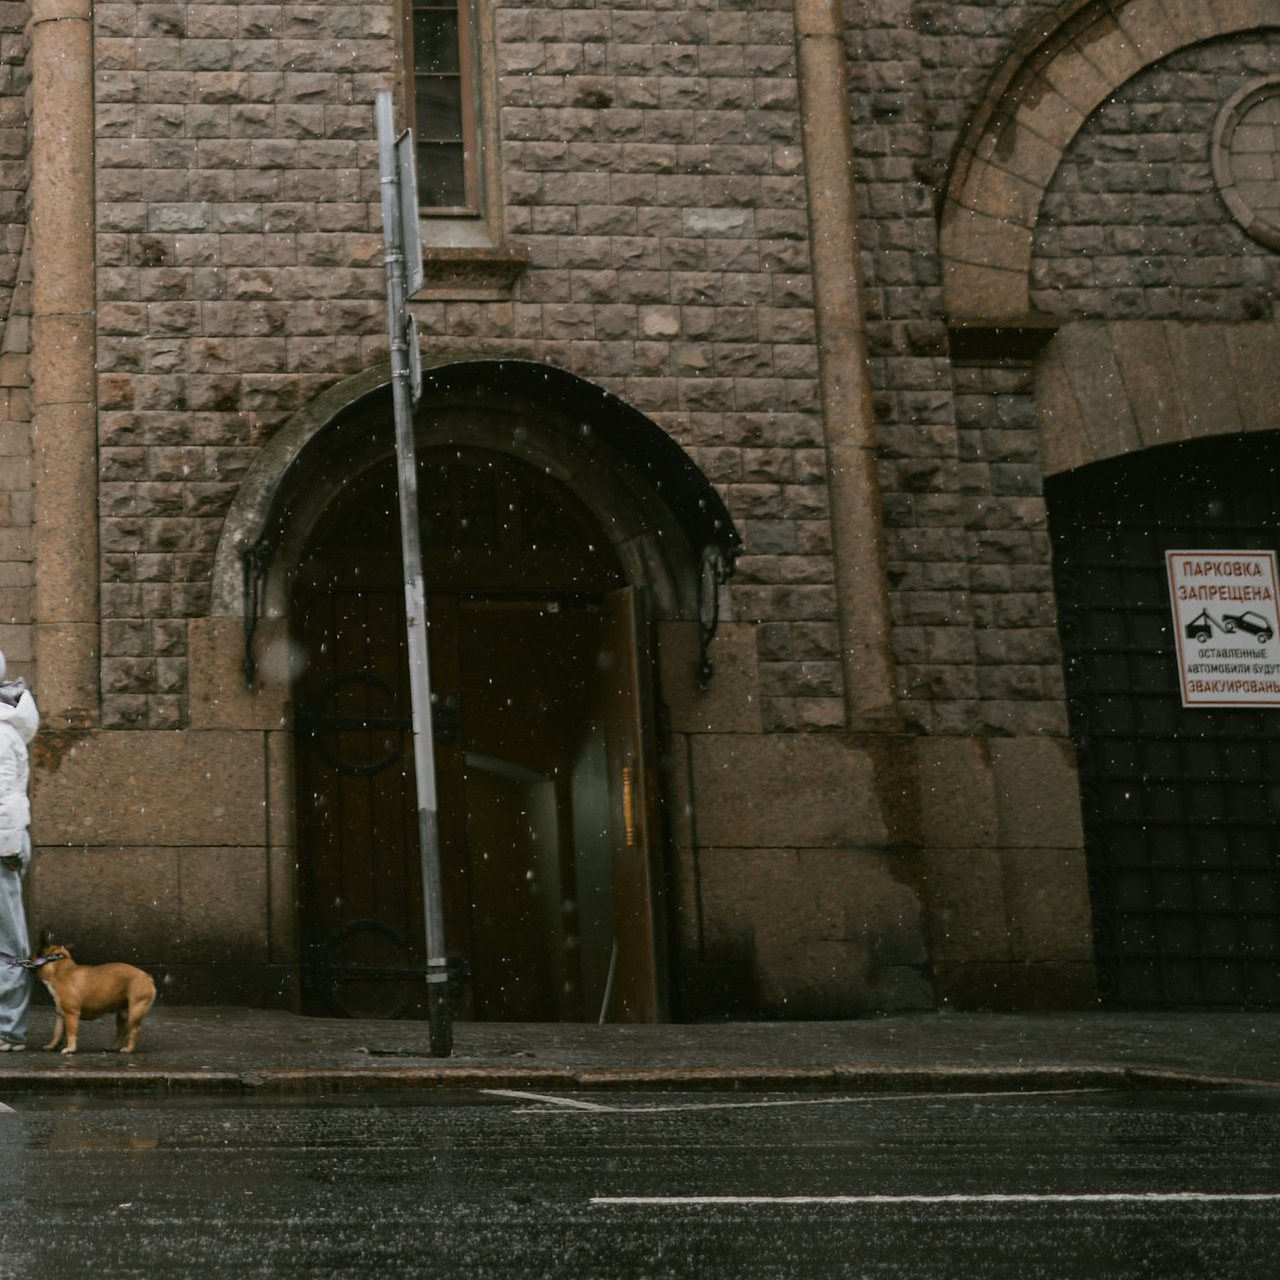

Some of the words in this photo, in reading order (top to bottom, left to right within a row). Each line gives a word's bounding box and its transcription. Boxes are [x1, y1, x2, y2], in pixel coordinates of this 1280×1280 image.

[1183, 561, 1262, 577] ПАРКОВКА
[1178, 585, 1272, 604] ЗАПРЕЩЕНА
[1198, 648, 1268, 659] ОСТАВЛЕННЫЕ
[1187, 664, 1250, 674] АВТОМОБИЛИ
